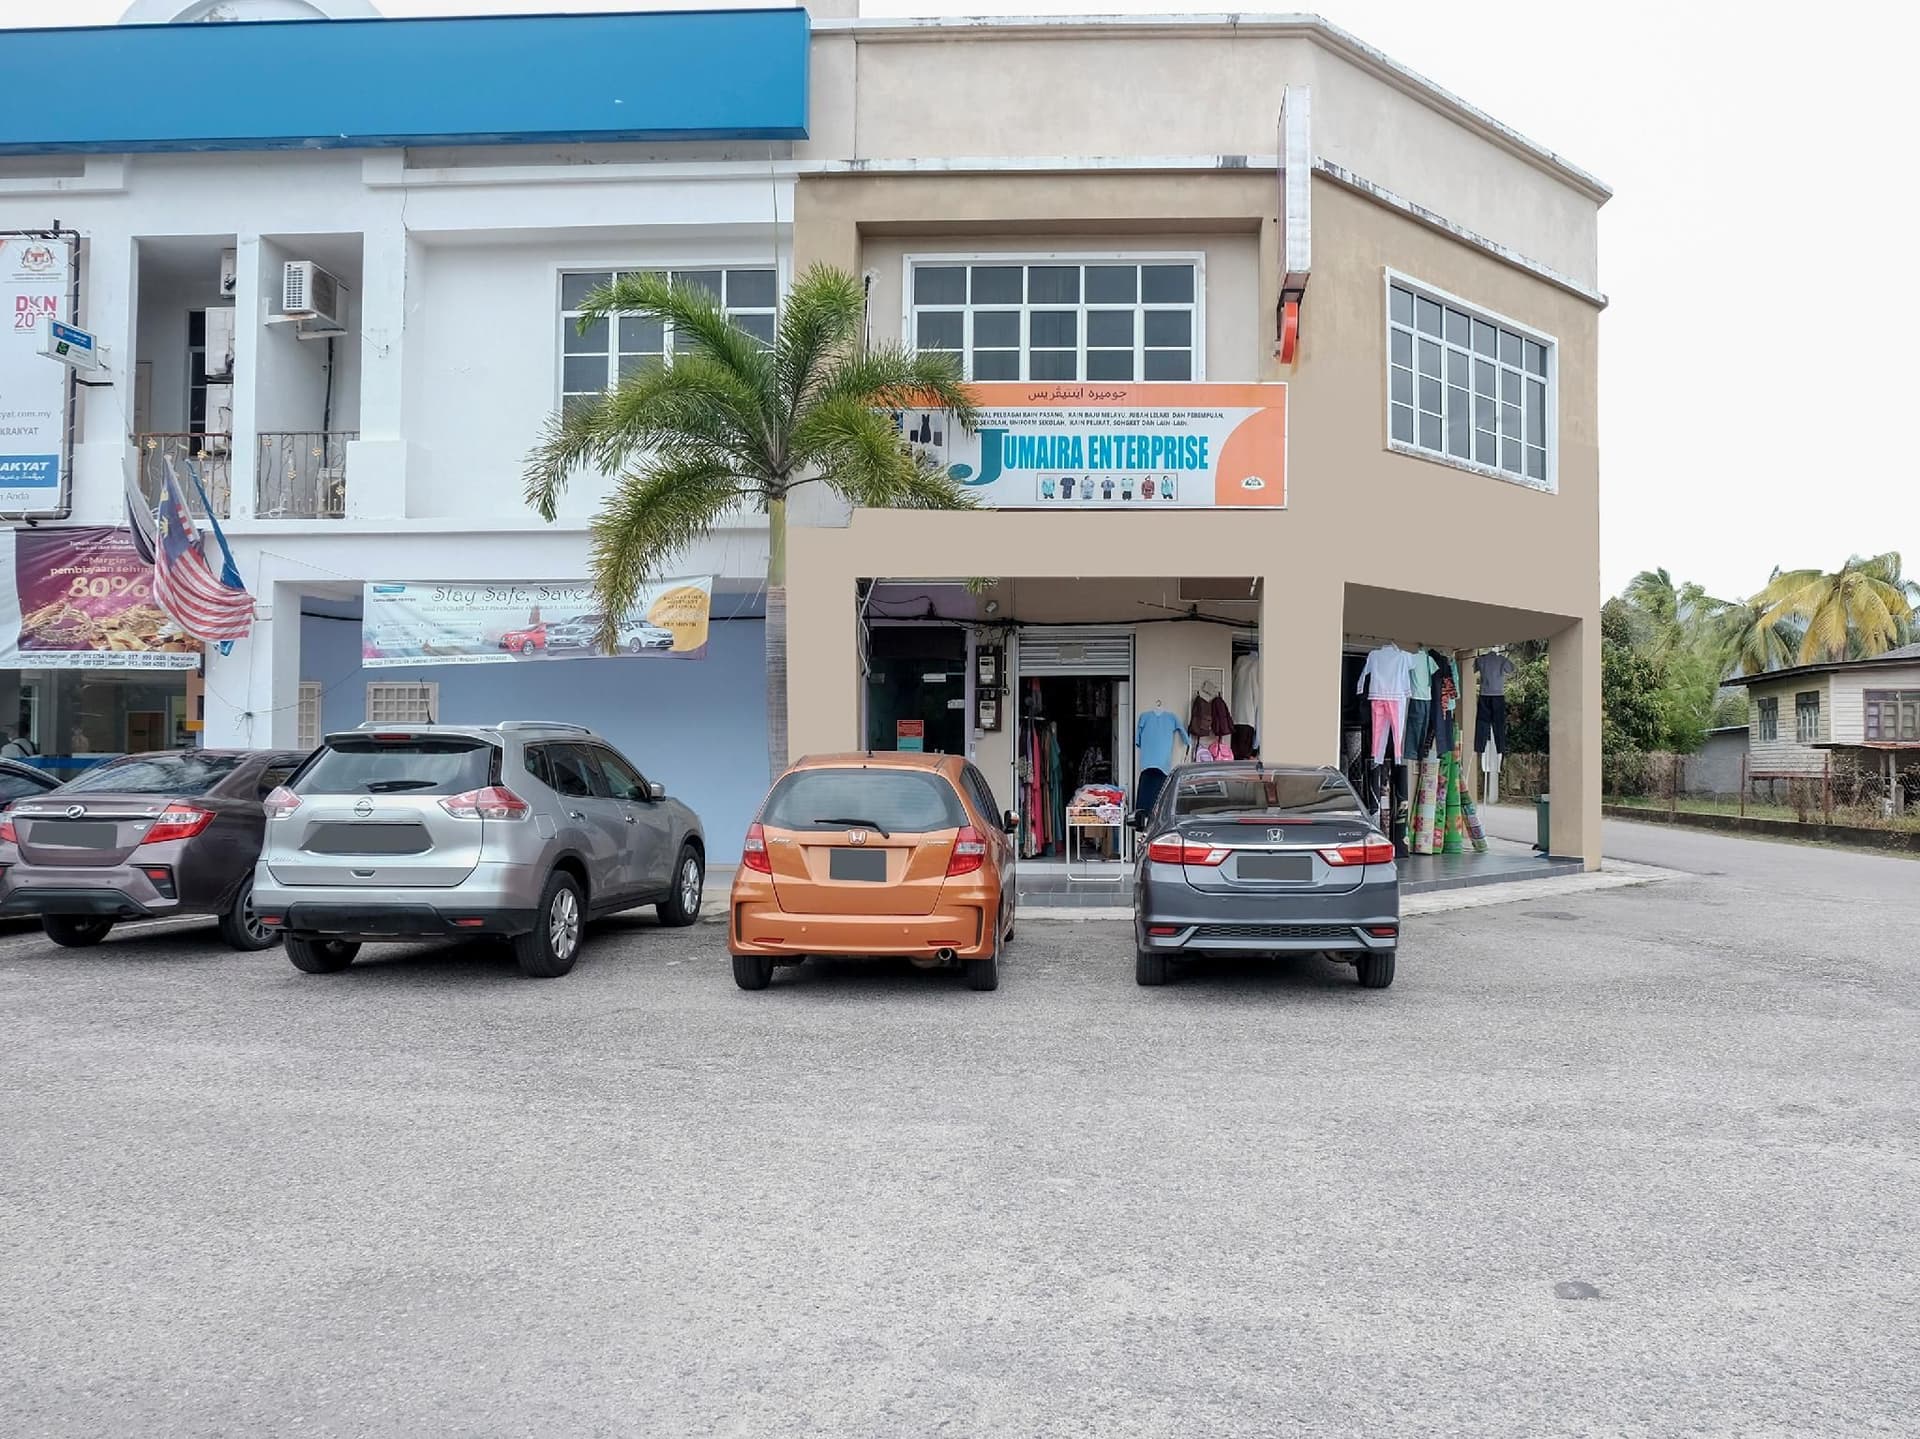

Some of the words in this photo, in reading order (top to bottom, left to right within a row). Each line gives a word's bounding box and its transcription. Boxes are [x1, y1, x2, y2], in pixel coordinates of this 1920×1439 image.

[14, 312, 56, 328] 20
[0, 410, 51, 420] yat.com.my
[1068, 411, 1084, 419] KAIN
[1084, 411, 1100, 419] BAJU
[947, 428, 1084, 486] JUMAIRA
[1087, 434, 1209, 471] ENTERPRISE
[67, 575, 151, 599] 80%
[431, 586, 477, 606] Stay
